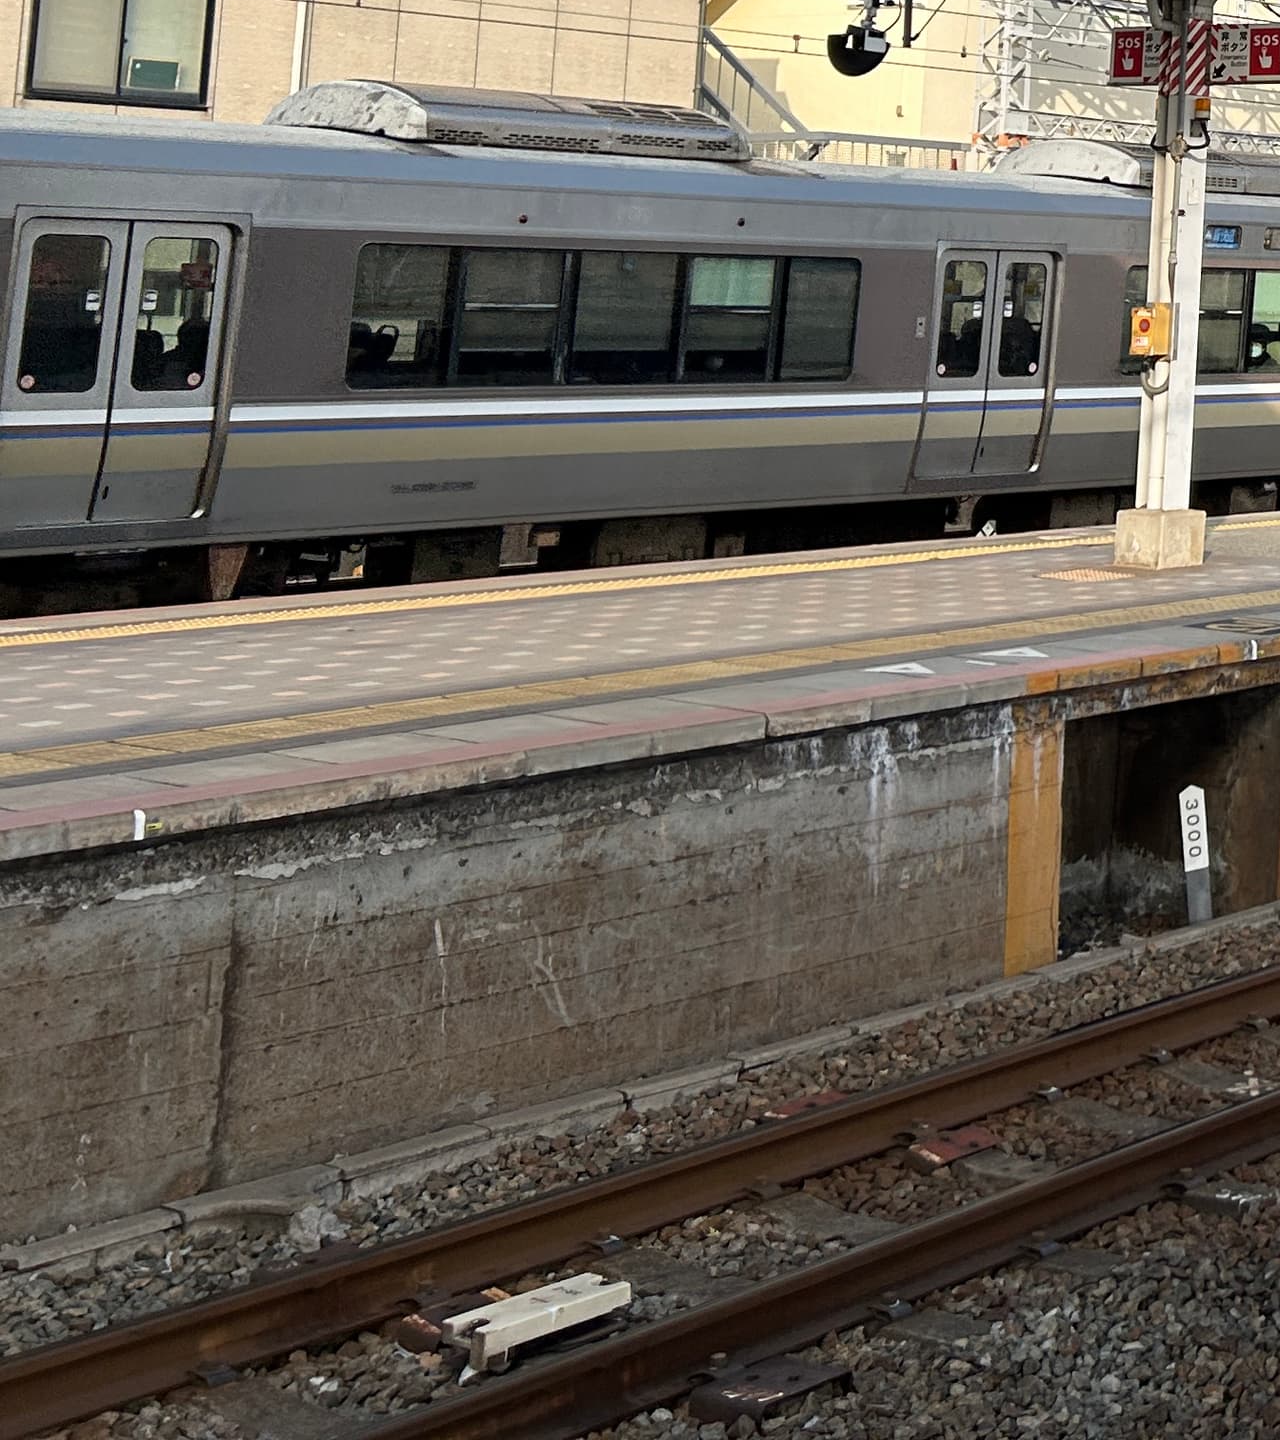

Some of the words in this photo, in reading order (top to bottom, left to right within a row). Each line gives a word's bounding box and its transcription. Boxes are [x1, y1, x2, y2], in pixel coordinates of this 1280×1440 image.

[1118, 37, 1141, 49] SOS
[1252, 34, 1280, 47] SOS
[1220, 42, 1248, 53] ボタン
[1186, 799, 1201, 857] 3000
